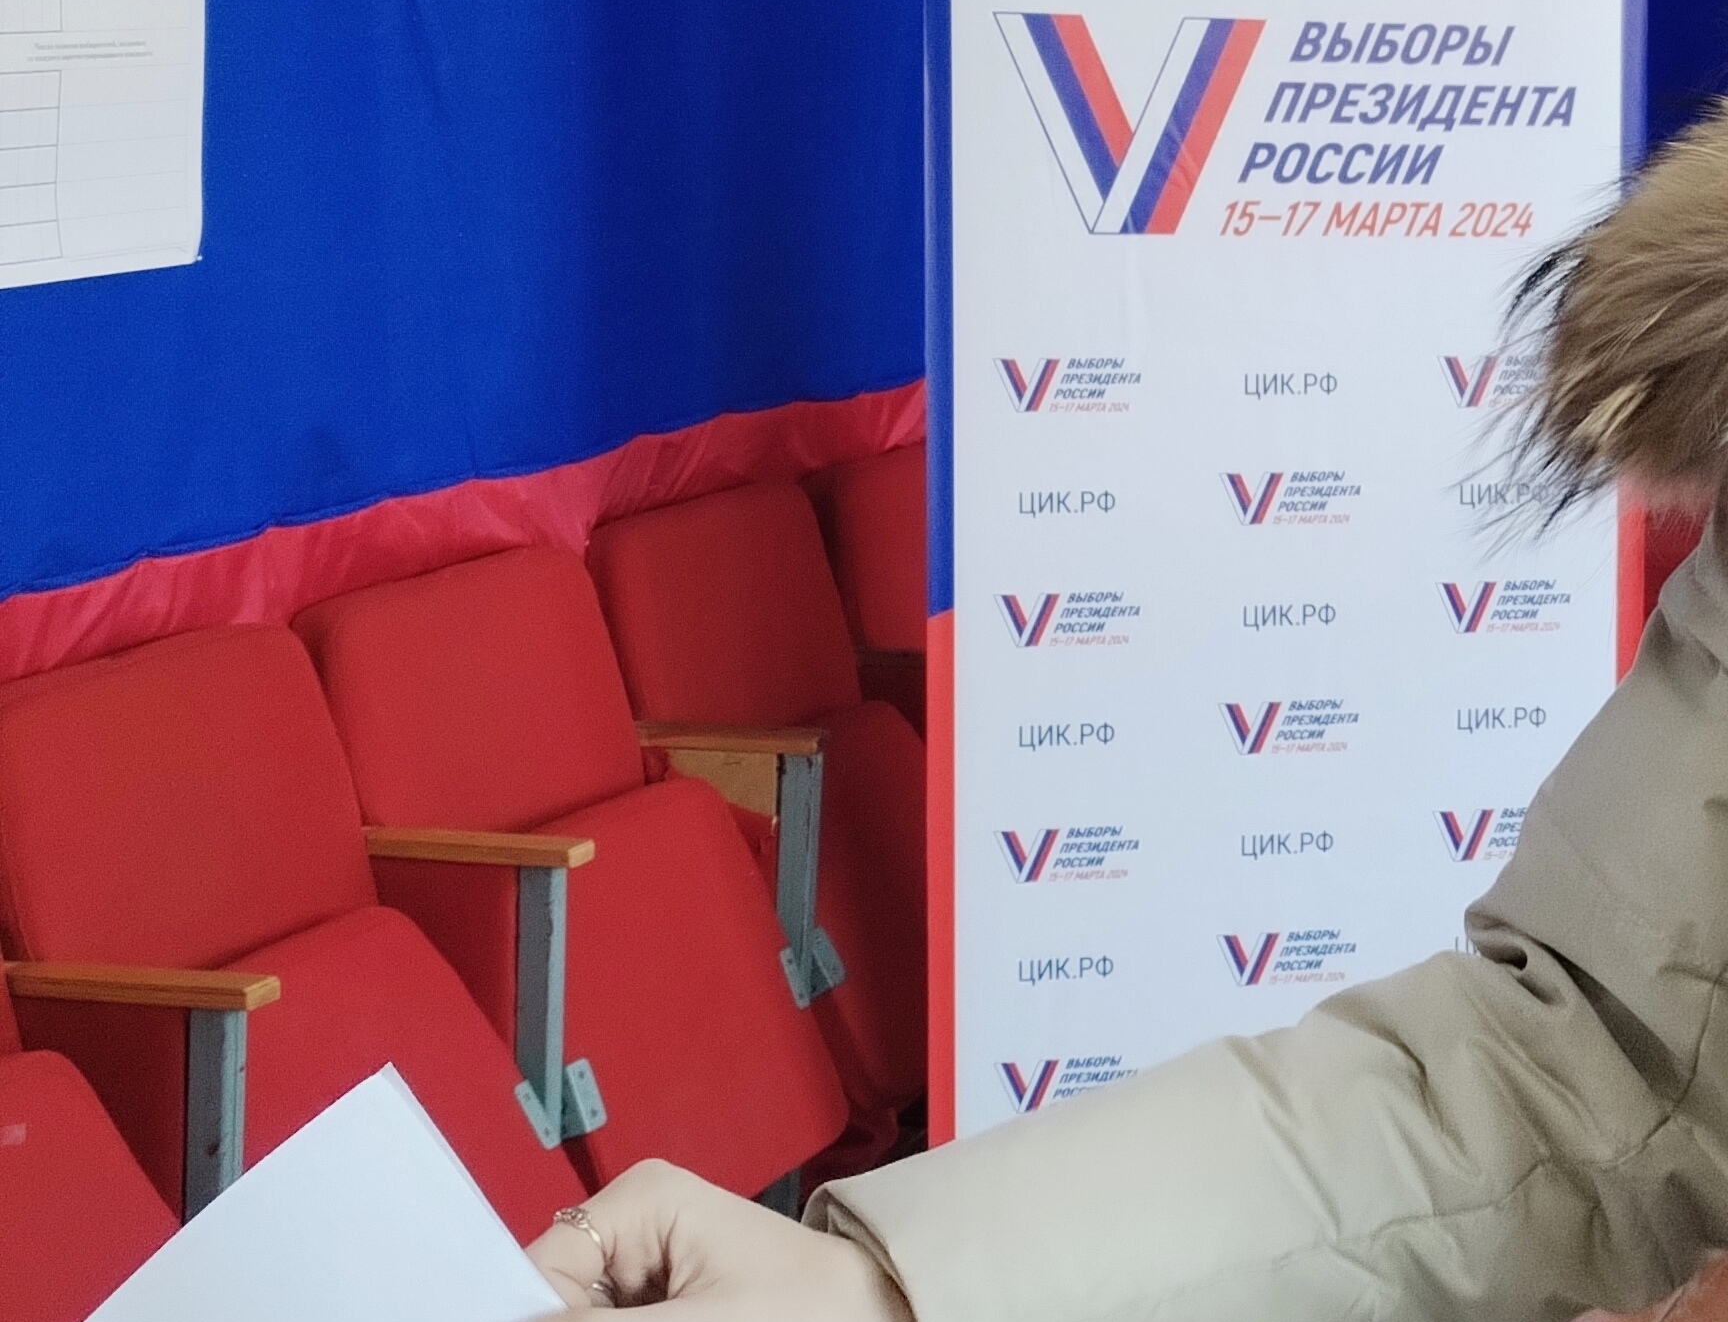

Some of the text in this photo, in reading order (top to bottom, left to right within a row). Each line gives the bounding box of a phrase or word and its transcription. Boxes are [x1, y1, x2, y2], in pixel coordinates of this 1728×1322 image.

[1291, 22, 1515, 66] ВЫБОРЫ
[1264, 83, 1577, 131] ПРЕЗИДЕНТА
[1239, 143, 1444, 185] РОССИИ
[1322, 202, 1441, 237] МАРТА
[1449, 203, 1534, 238] 2024
[1068, 359, 1125, 369] ВЫБОРЫ
[1062, 374, 1141, 385] ПРЕЗИДЕНТА
[1244, 372, 1338, 401] ЦИК.РФ
[1055, 389, 1107, 399] РОССИИ
[1291, 472, 1346, 483] ВЫБОРЫ
[1285, 486, 1361, 498] ПРЕЗИДЕНТА
[1019, 490, 1116, 519] ЦИК.РФ
[1279, 501, 1328, 512] РОССИИ
[1504, 581, 1557, 591] ВЫБОРЫ
[1068, 593, 1125, 604] ВЫБОРЫ
[1498, 594, 1571, 606] ПРЕЗИДЕНТА
[1061, 607, 1140, 619] ПРЕЗИДЕНТА
[1243, 602, 1337, 632] ЦИК.РФ
[1492, 609, 1540, 620] РОССИИ
[1055, 622, 1107, 633] РОССИИ
[1290, 700, 1344, 712] ВЫБОРЫ
[1283, 714, 1359, 726] ПРЕЗИДЕНТА
[1457, 706, 1547, 735] ЦИК.РФ
[1018, 721, 1115, 752] ЦИК.РФ
[1277, 729, 1326, 741] РОССИИ
[1068, 827, 1124, 839] ВЫБОРЫ
[1061, 840, 1139, 853] ПРЕЗИДЕНТА
[1241, 830, 1334, 861] ЦИК.РФ
[1054, 856, 1106, 868] РОССИИ
[1287, 930, 1341, 942] ВЫБОРЫ
[1281, 943, 1356, 957] ПРЕЗИДЕНТА
[1018, 955, 1114, 987] ЦИК.РФ
[1275, 959, 1324, 971] РОССИИ
[1067, 1057, 1122, 1069] ВЫБОРЫ
